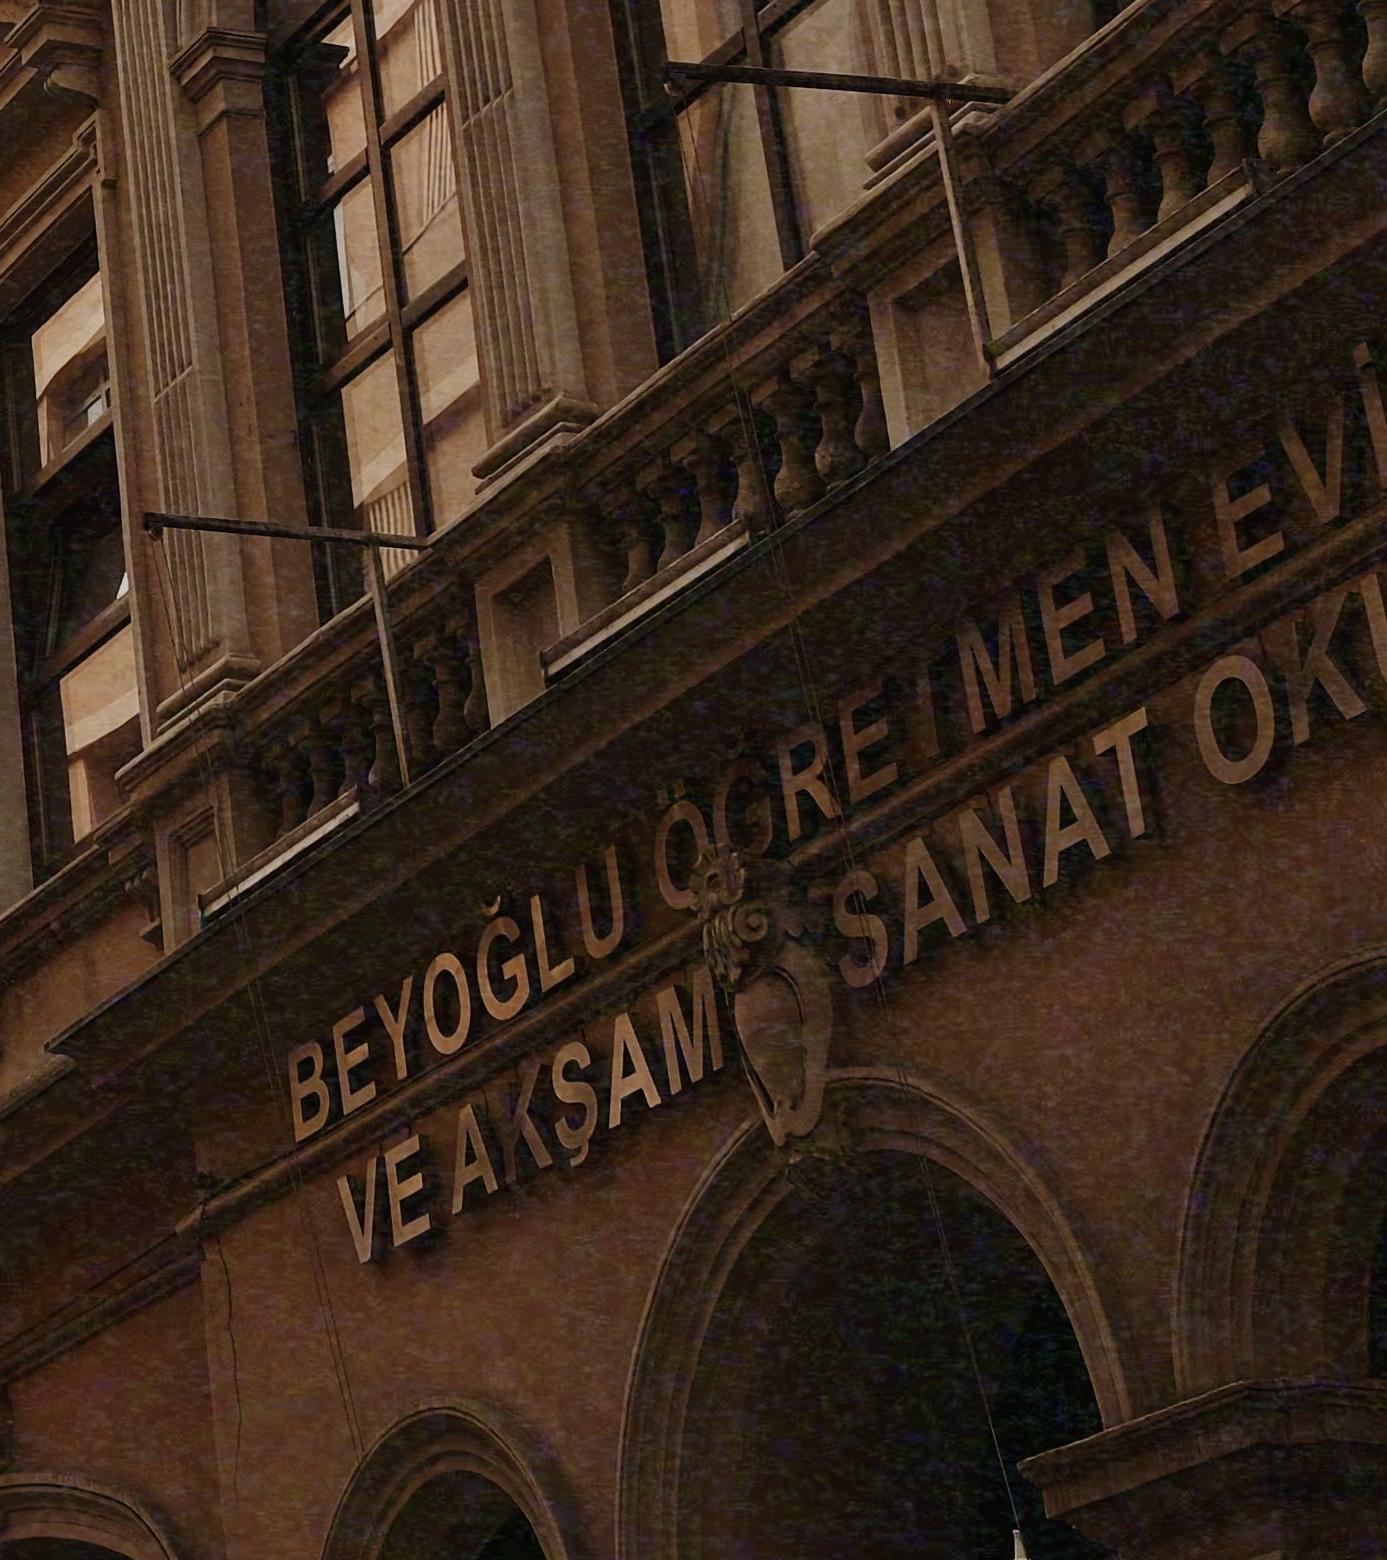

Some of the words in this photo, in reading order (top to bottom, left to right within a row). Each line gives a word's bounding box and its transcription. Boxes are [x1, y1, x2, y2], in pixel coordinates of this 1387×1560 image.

[288, 843, 625, 1144] BEYOĞLU
[336, 1133, 431, 1264] VE
[452, 965, 725, 1216] AKŞAM
[832, 707, 1148, 989] SANAT
